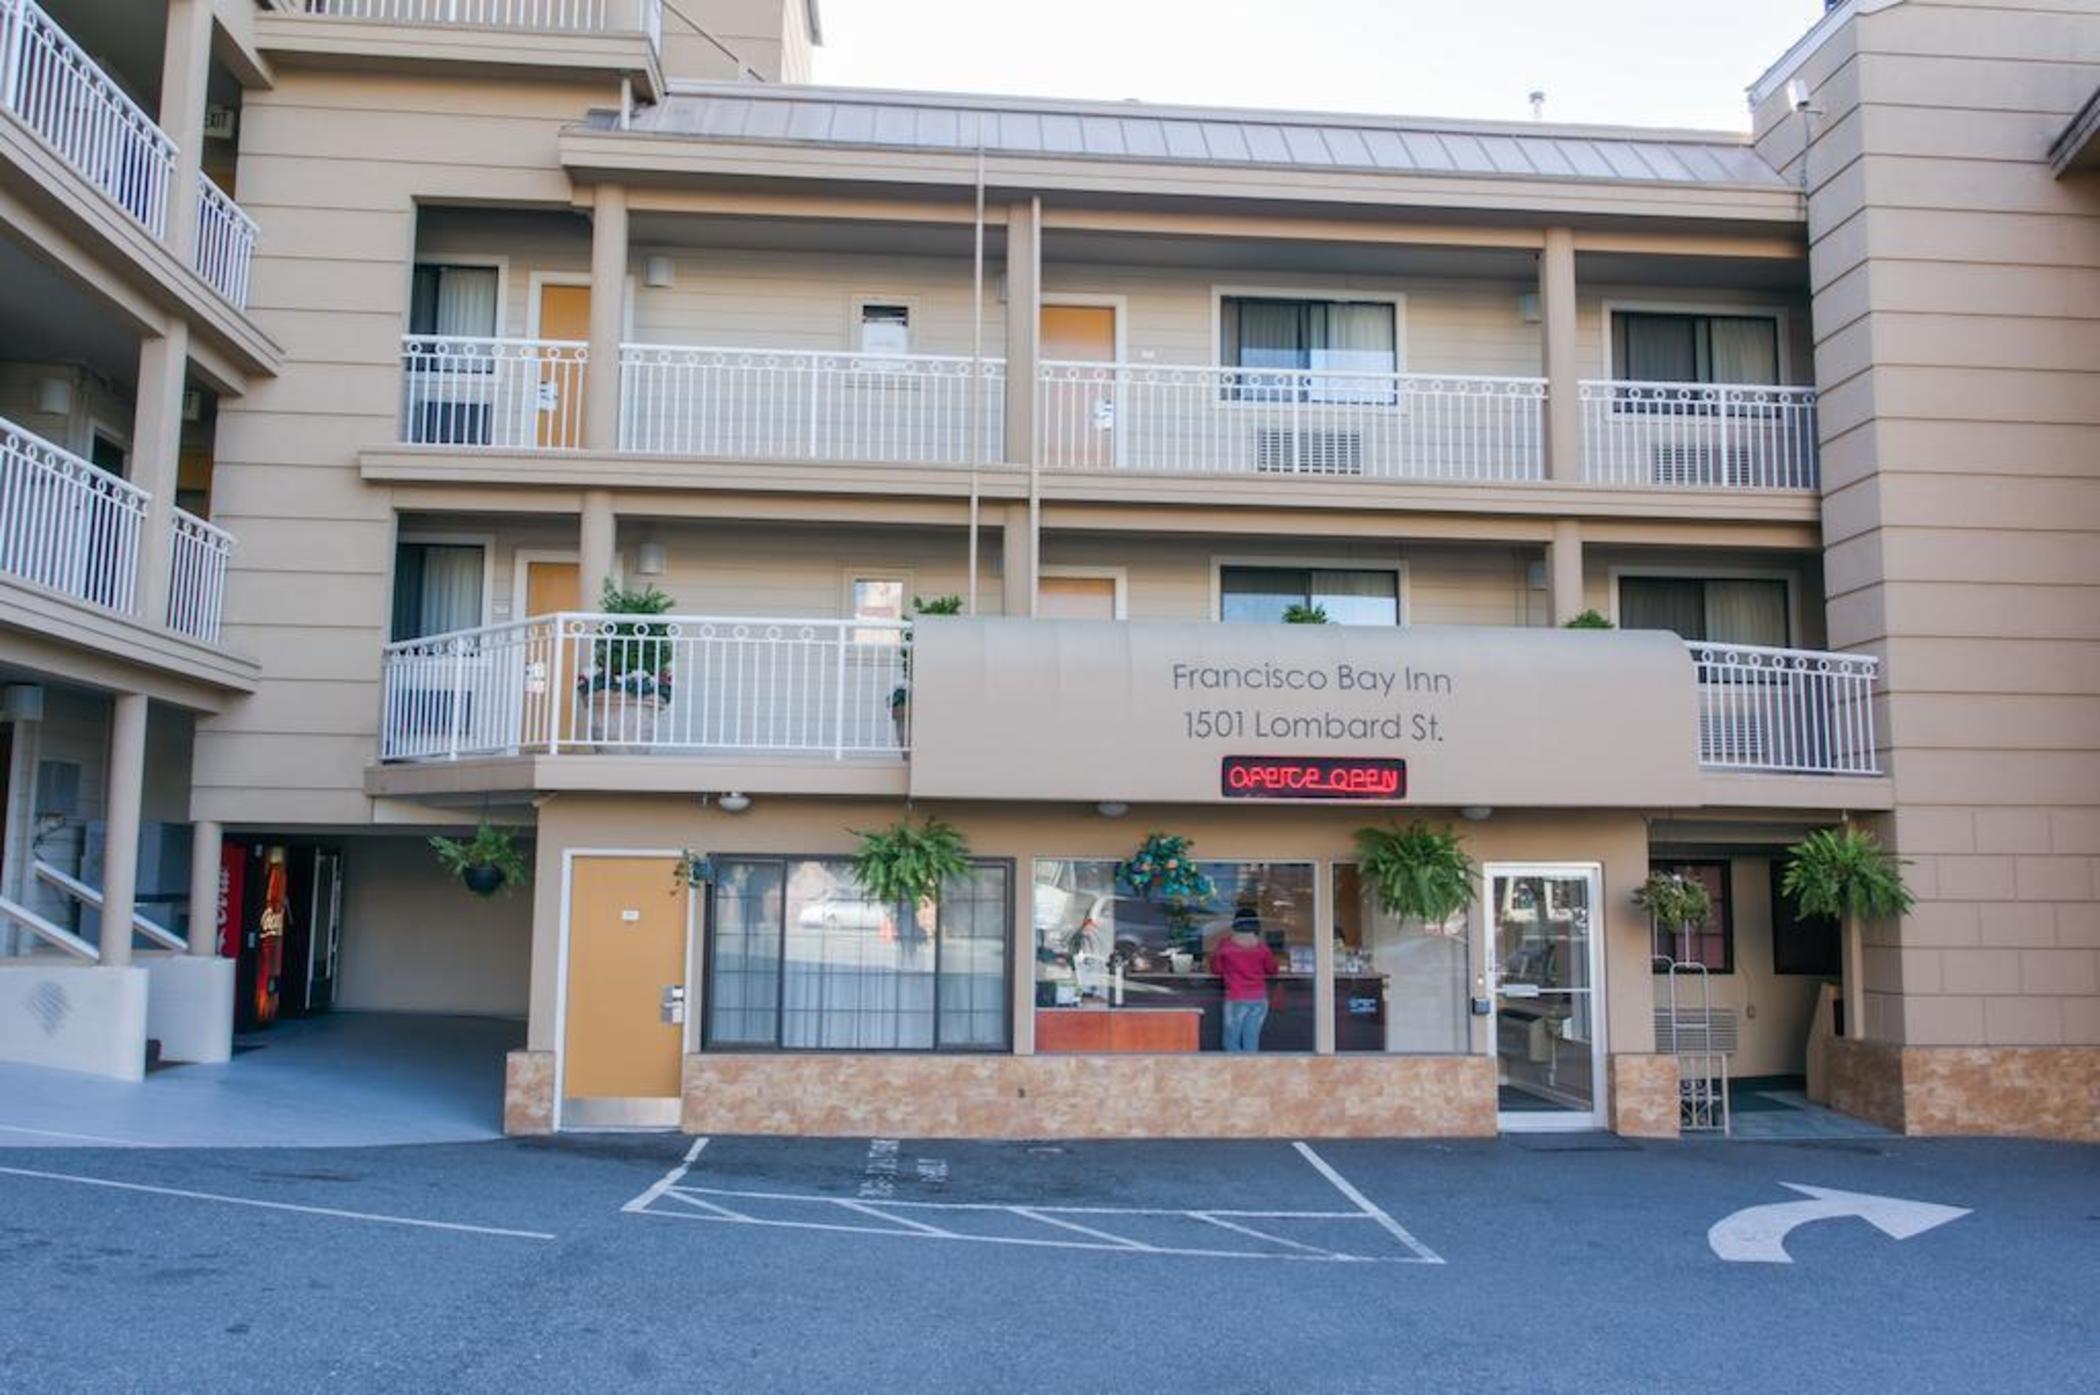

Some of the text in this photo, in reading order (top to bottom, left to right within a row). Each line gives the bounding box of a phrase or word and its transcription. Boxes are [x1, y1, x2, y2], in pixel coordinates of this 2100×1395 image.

[1174, 663, 1452, 696] Francisco Bay Inn
[1184, 711, 1443, 741] 1501 Lombard St.
